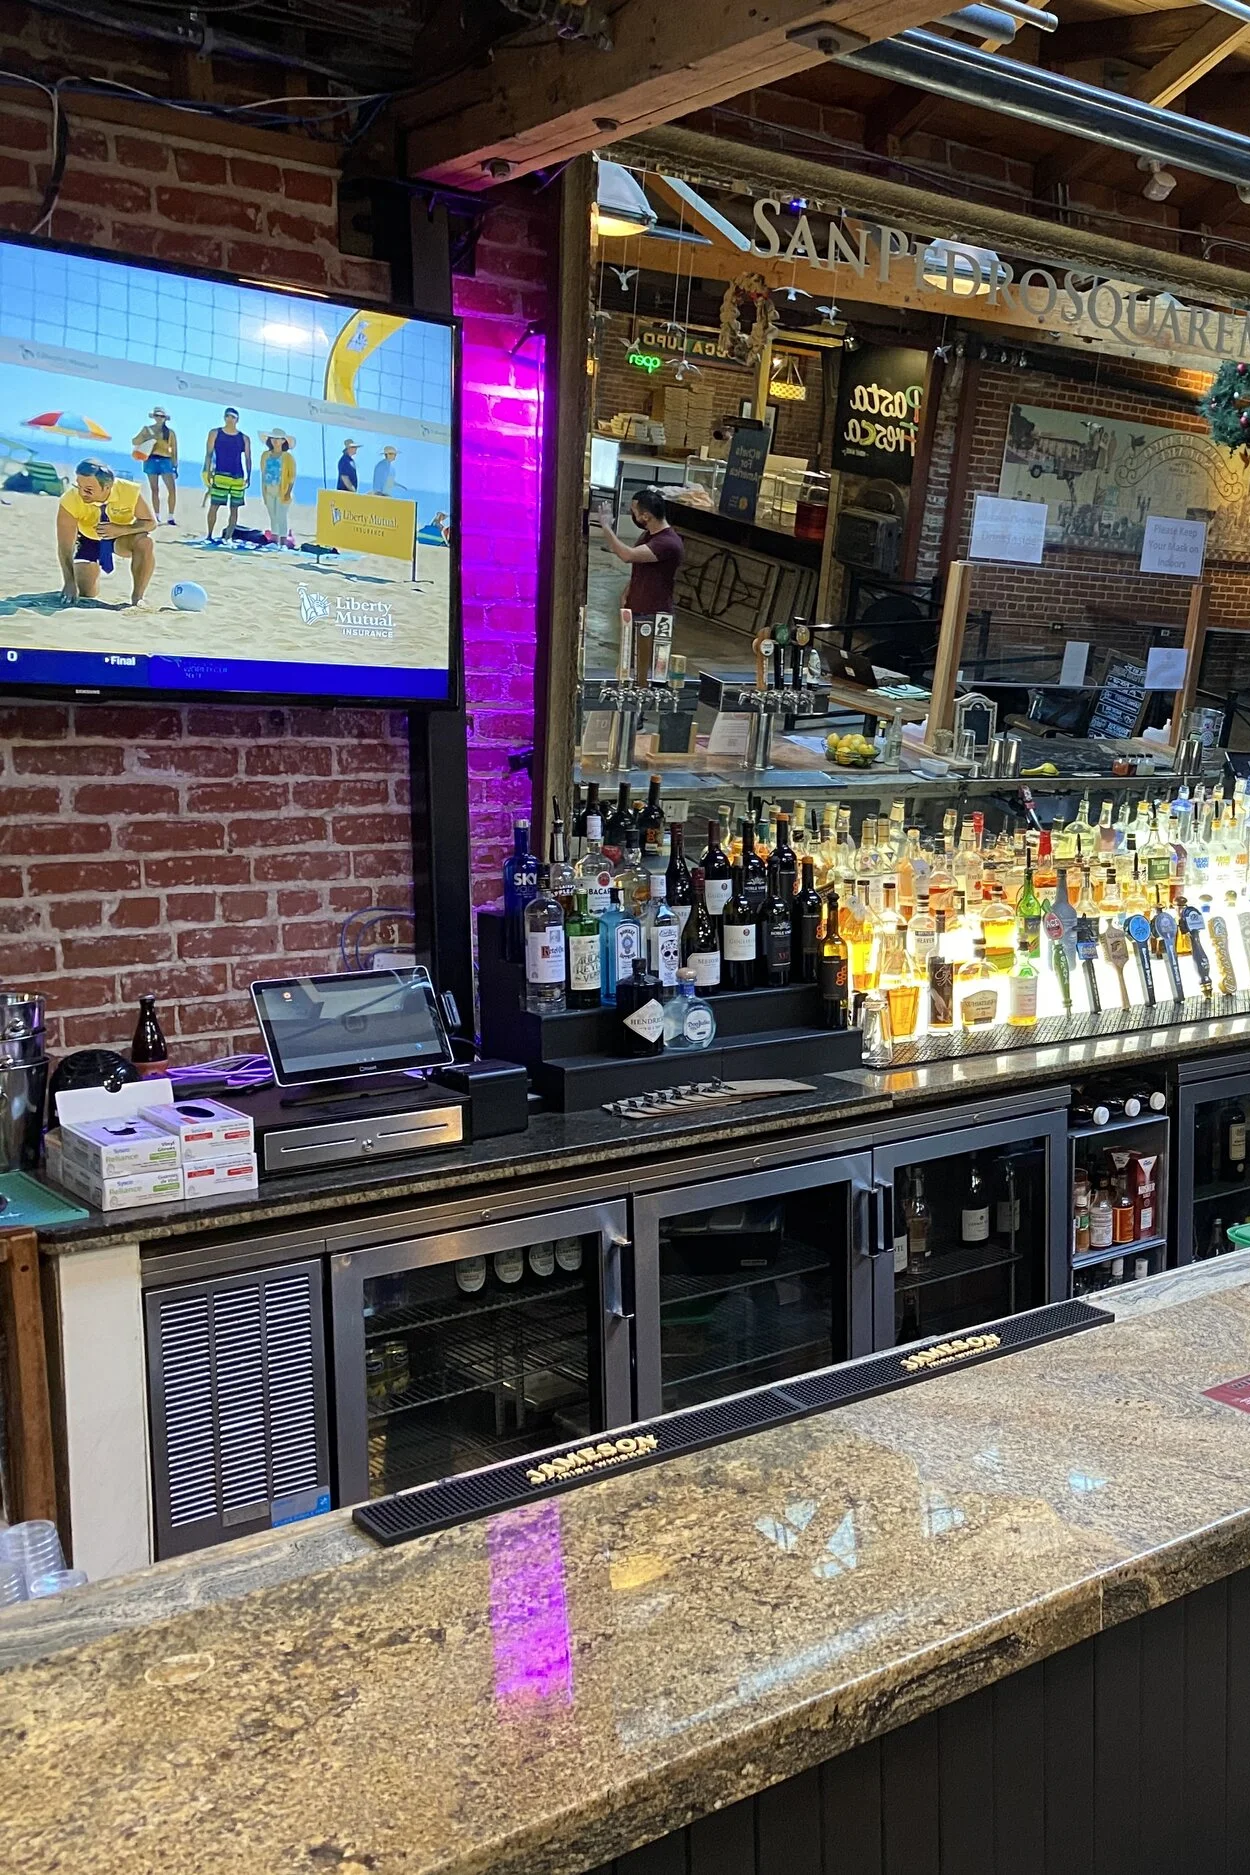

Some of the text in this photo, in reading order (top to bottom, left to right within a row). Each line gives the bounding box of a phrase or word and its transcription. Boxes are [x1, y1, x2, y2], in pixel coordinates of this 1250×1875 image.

[1060, 269, 1240, 354] SQUARE
[343, 509, 368, 524] Liberty
[353, 526, 385, 538] INSURANCE
[1154, 524, 1198, 540] Please Keep
[1148, 540, 1199, 554] Your Mask on
[336, 596, 393, 616] Liberty
[342, 628, 394, 638] INSURANCE
[110, 656, 136, 666] Final
[514, 873, 537, 885] SKY
[1046, 918, 1060, 928] ACE
[105, 1153, 139, 1163] Reliance
[109, 1186, 143, 1195] Reliance
[900, 1334, 1000, 1372] JAMESON
[526, 1435, 658, 1485] JAMESON
